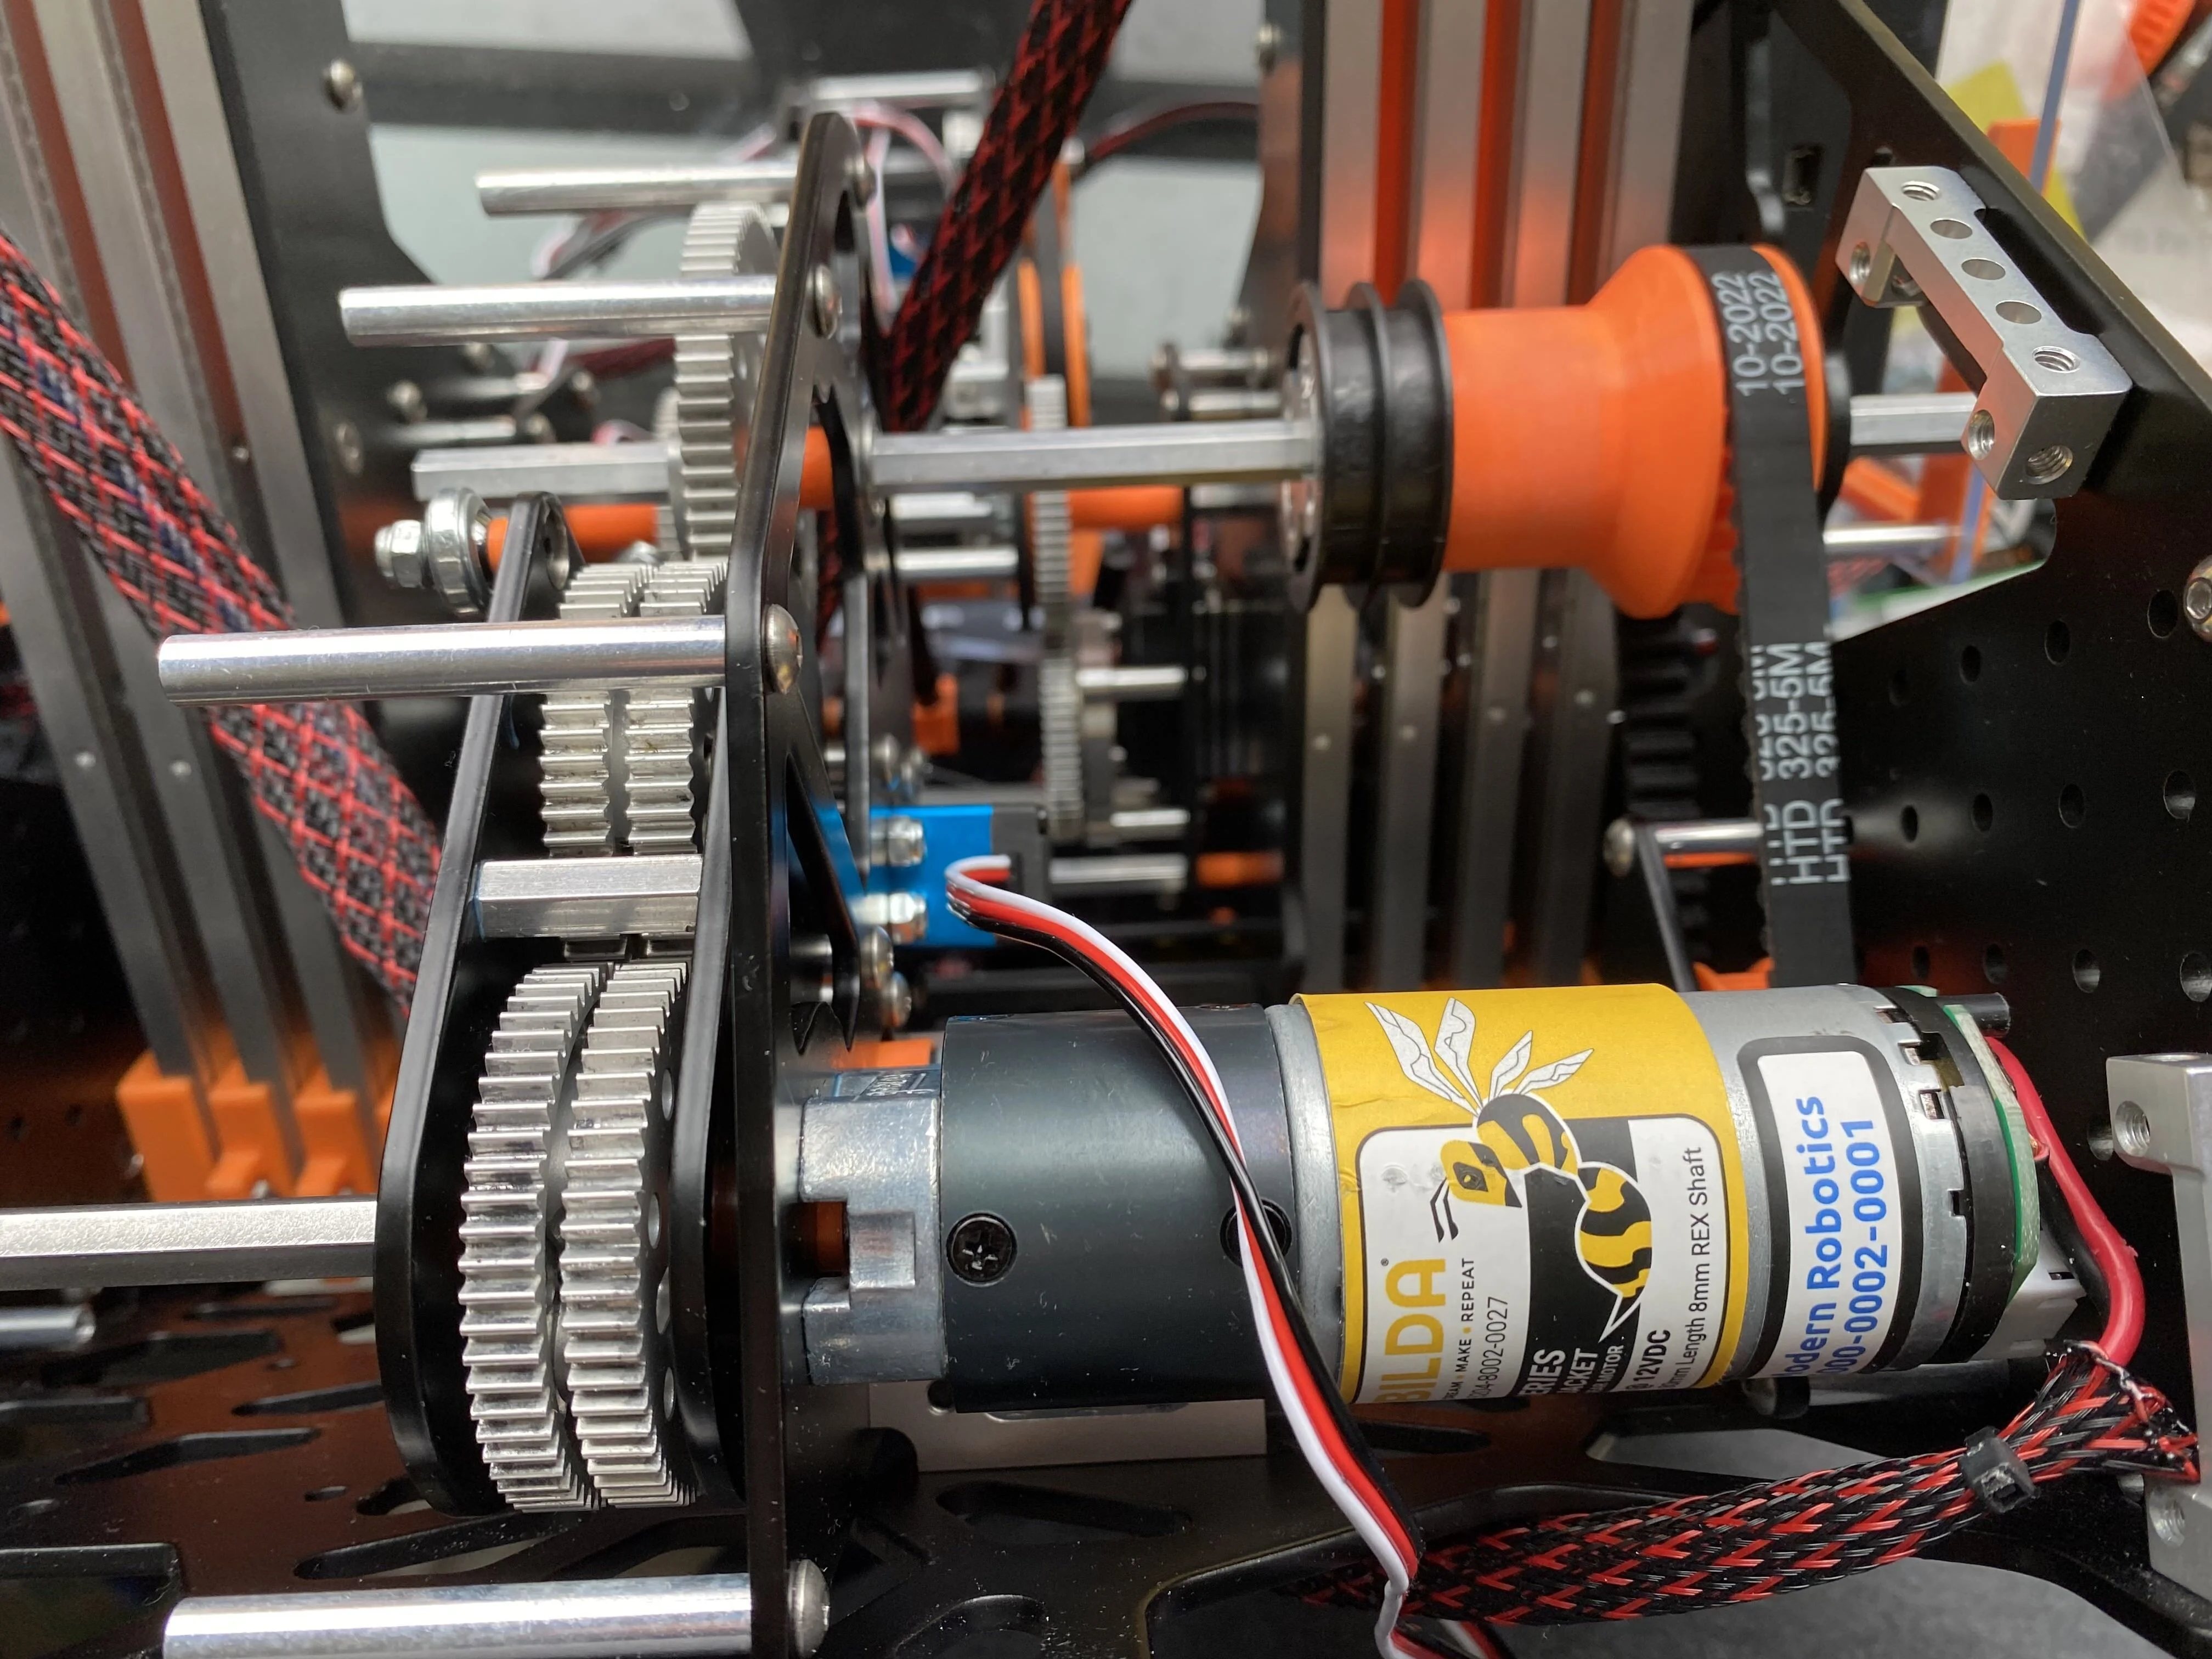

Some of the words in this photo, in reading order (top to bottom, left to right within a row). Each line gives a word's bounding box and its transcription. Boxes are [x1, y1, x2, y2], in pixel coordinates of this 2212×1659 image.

[1711, 272, 1769, 397] 10-2022
[1747, 272, 1805, 395] 10-2022
[1766, 643, 1814, 780] 325-5M
[1782, 799, 1824, 885] HTD
[1683, 1147, 1708, 1206] Shaft
[1796, 1096, 1843, 1290] Robotics
[1689, 1212, 1711, 1256] REX
[1461, 1257, 1475, 1322] REPEAT
[1688, 1262, 1710, 1312] 8mm
[1455, 1339, 1472, 1372] MAKE
[1596, 1345, 1624, 1384] MOTOR
[1633, 1329, 1671, 1380] 12VDC
[1676, 1316, 1707, 1366] Length
